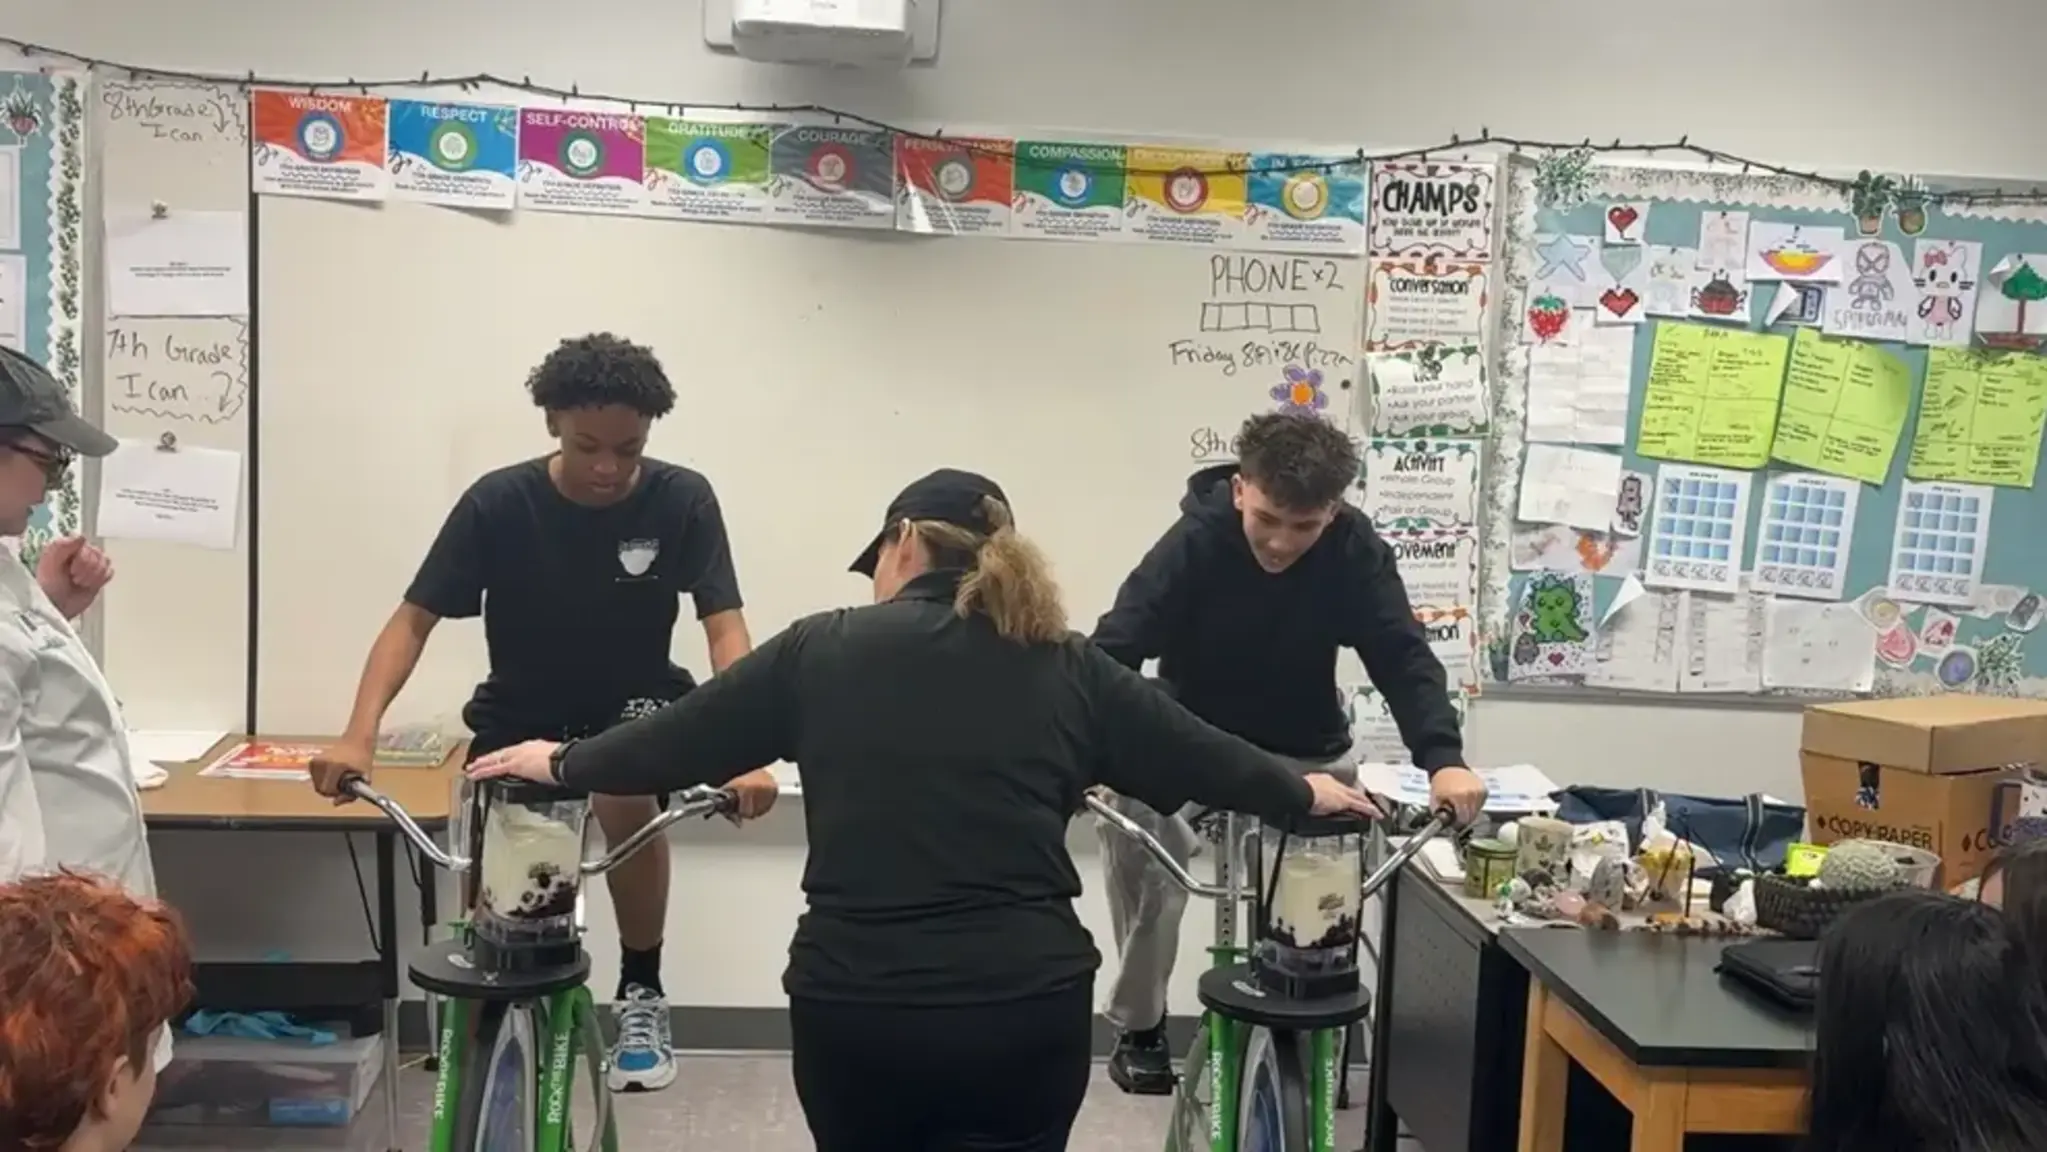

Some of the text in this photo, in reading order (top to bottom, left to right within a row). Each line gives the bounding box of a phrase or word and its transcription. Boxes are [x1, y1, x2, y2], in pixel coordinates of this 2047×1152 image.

[103, 91, 212, 120] 8th Grade
[288, 95, 353, 113] WISDOM
[420, 106, 488, 123] RESPECT
[525, 112, 640, 132] SELF-CONTROL
[668, 121, 747, 139] GRATITUDE
[797, 130, 868, 146] COURAGE
[1029, 145, 1121, 161] COMPASSION
[1383, 180, 1481, 217] CHAMPS
[1211, 254, 1310, 297] PHONE
[106, 328, 233, 365] 7th Grade
[1169, 339, 1237, 377] Friday
[1828, 815, 1933, 850] COPY PAPER
[552, 1031, 570, 1070] BIKE
